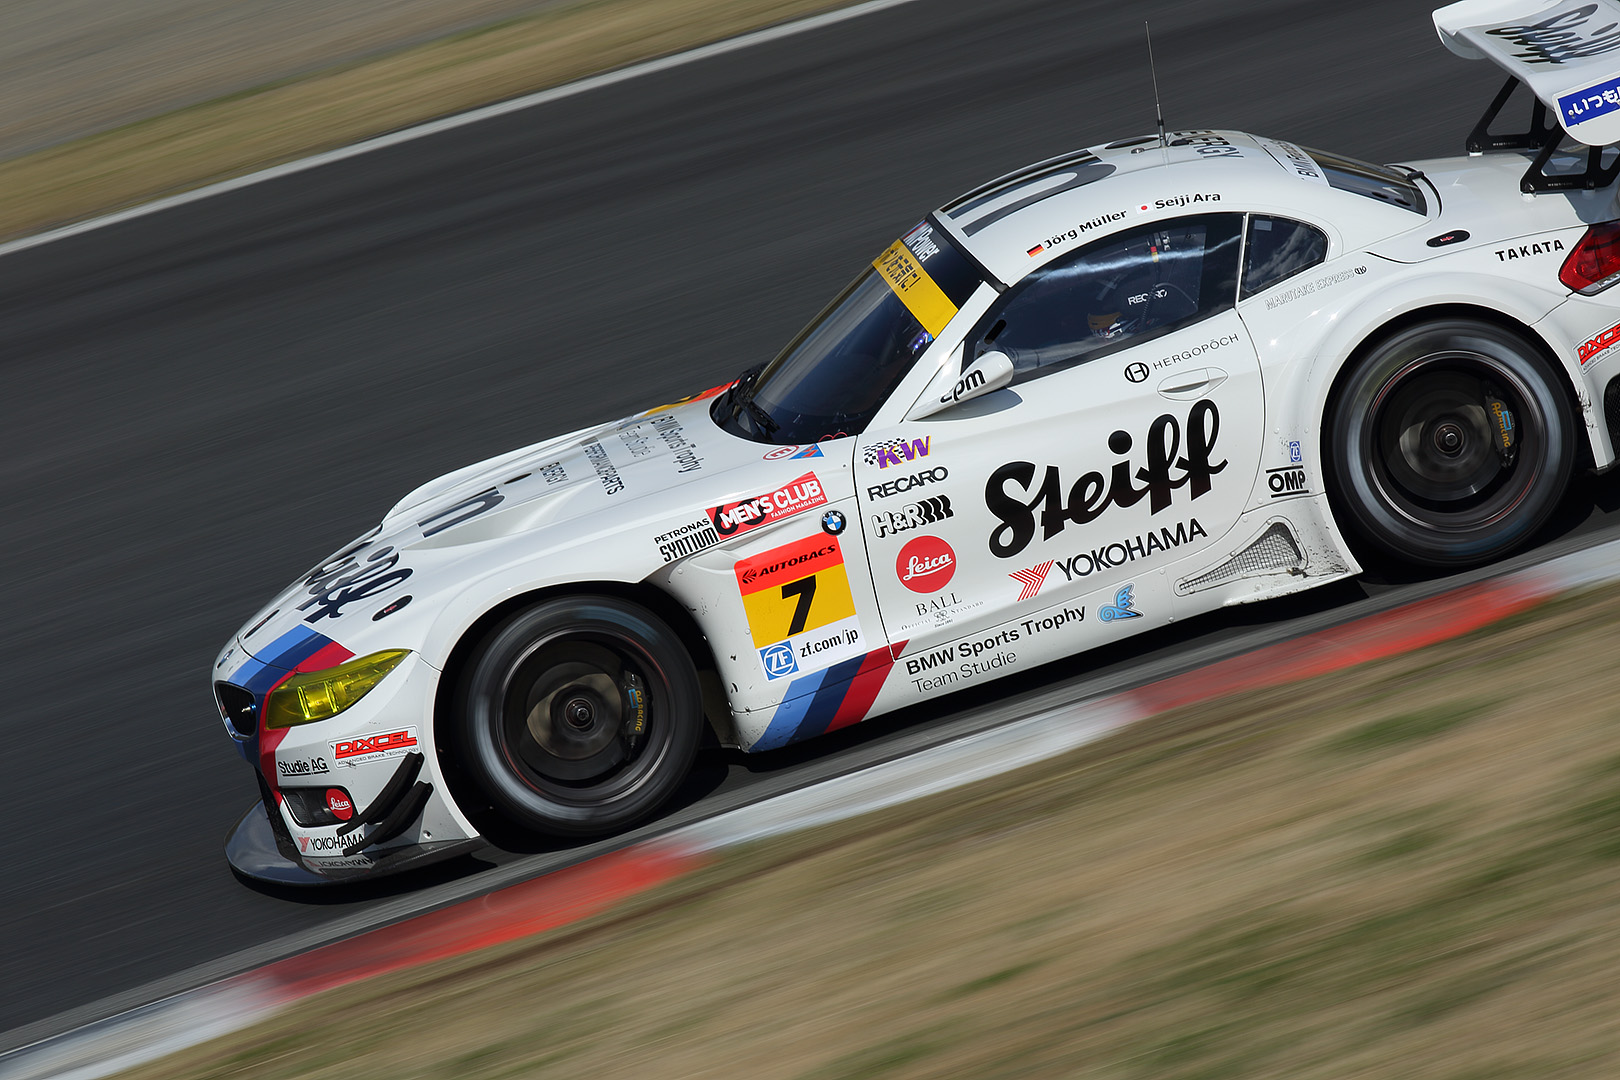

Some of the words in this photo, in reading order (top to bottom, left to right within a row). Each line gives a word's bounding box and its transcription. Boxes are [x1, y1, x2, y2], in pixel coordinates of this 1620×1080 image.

[1573, 86, 1620, 115] いつも
[1155, 194, 1190, 209] Seiji
[1193, 193, 1221, 203] Ara
[1044, 229, 1078, 248] Jörg
[1079, 210, 1127, 233] Müller
[1495, 239, 1565, 262] TAKATA
[673, 443, 705, 474] Trophy
[876, 436, 931, 469] KW
[867, 466, 949, 501] RECARO
[985, 398, 1229, 559] Steiff
[1267, 470, 1306, 492] OMP
[719, 496, 774, 528] MEN'S
[774, 480, 821, 510] CLUB
[771, 505, 796, 518] FASHION
[796, 496, 825, 511] MAGAZINE
[654, 517, 710, 544] PETRONAS
[871, 501, 926, 538] H&R
[659, 526, 719, 562] SYNTIUM
[1056, 517, 1208, 582] YOKOHAMA
[759, 544, 836, 578] AUTOBACS
[903, 552, 953, 581] Leica
[781, 575, 817, 637] 7
[916, 593, 962, 616] BALL
[800, 628, 859, 658] zf.com/jp
[906, 647, 955, 675] BMW
[958, 627, 1019, 658] Sports
[1021, 604, 1086, 636] Trophy
[765, 654, 790, 672] ZF
[911, 668, 958, 693] Team
[960, 650, 1018, 680] Studie
[336, 731, 416, 757] DIXCEL
[277, 759, 310, 774] Studie
[311, 757, 328, 772] AG
[330, 797, 351, 811] Leica
